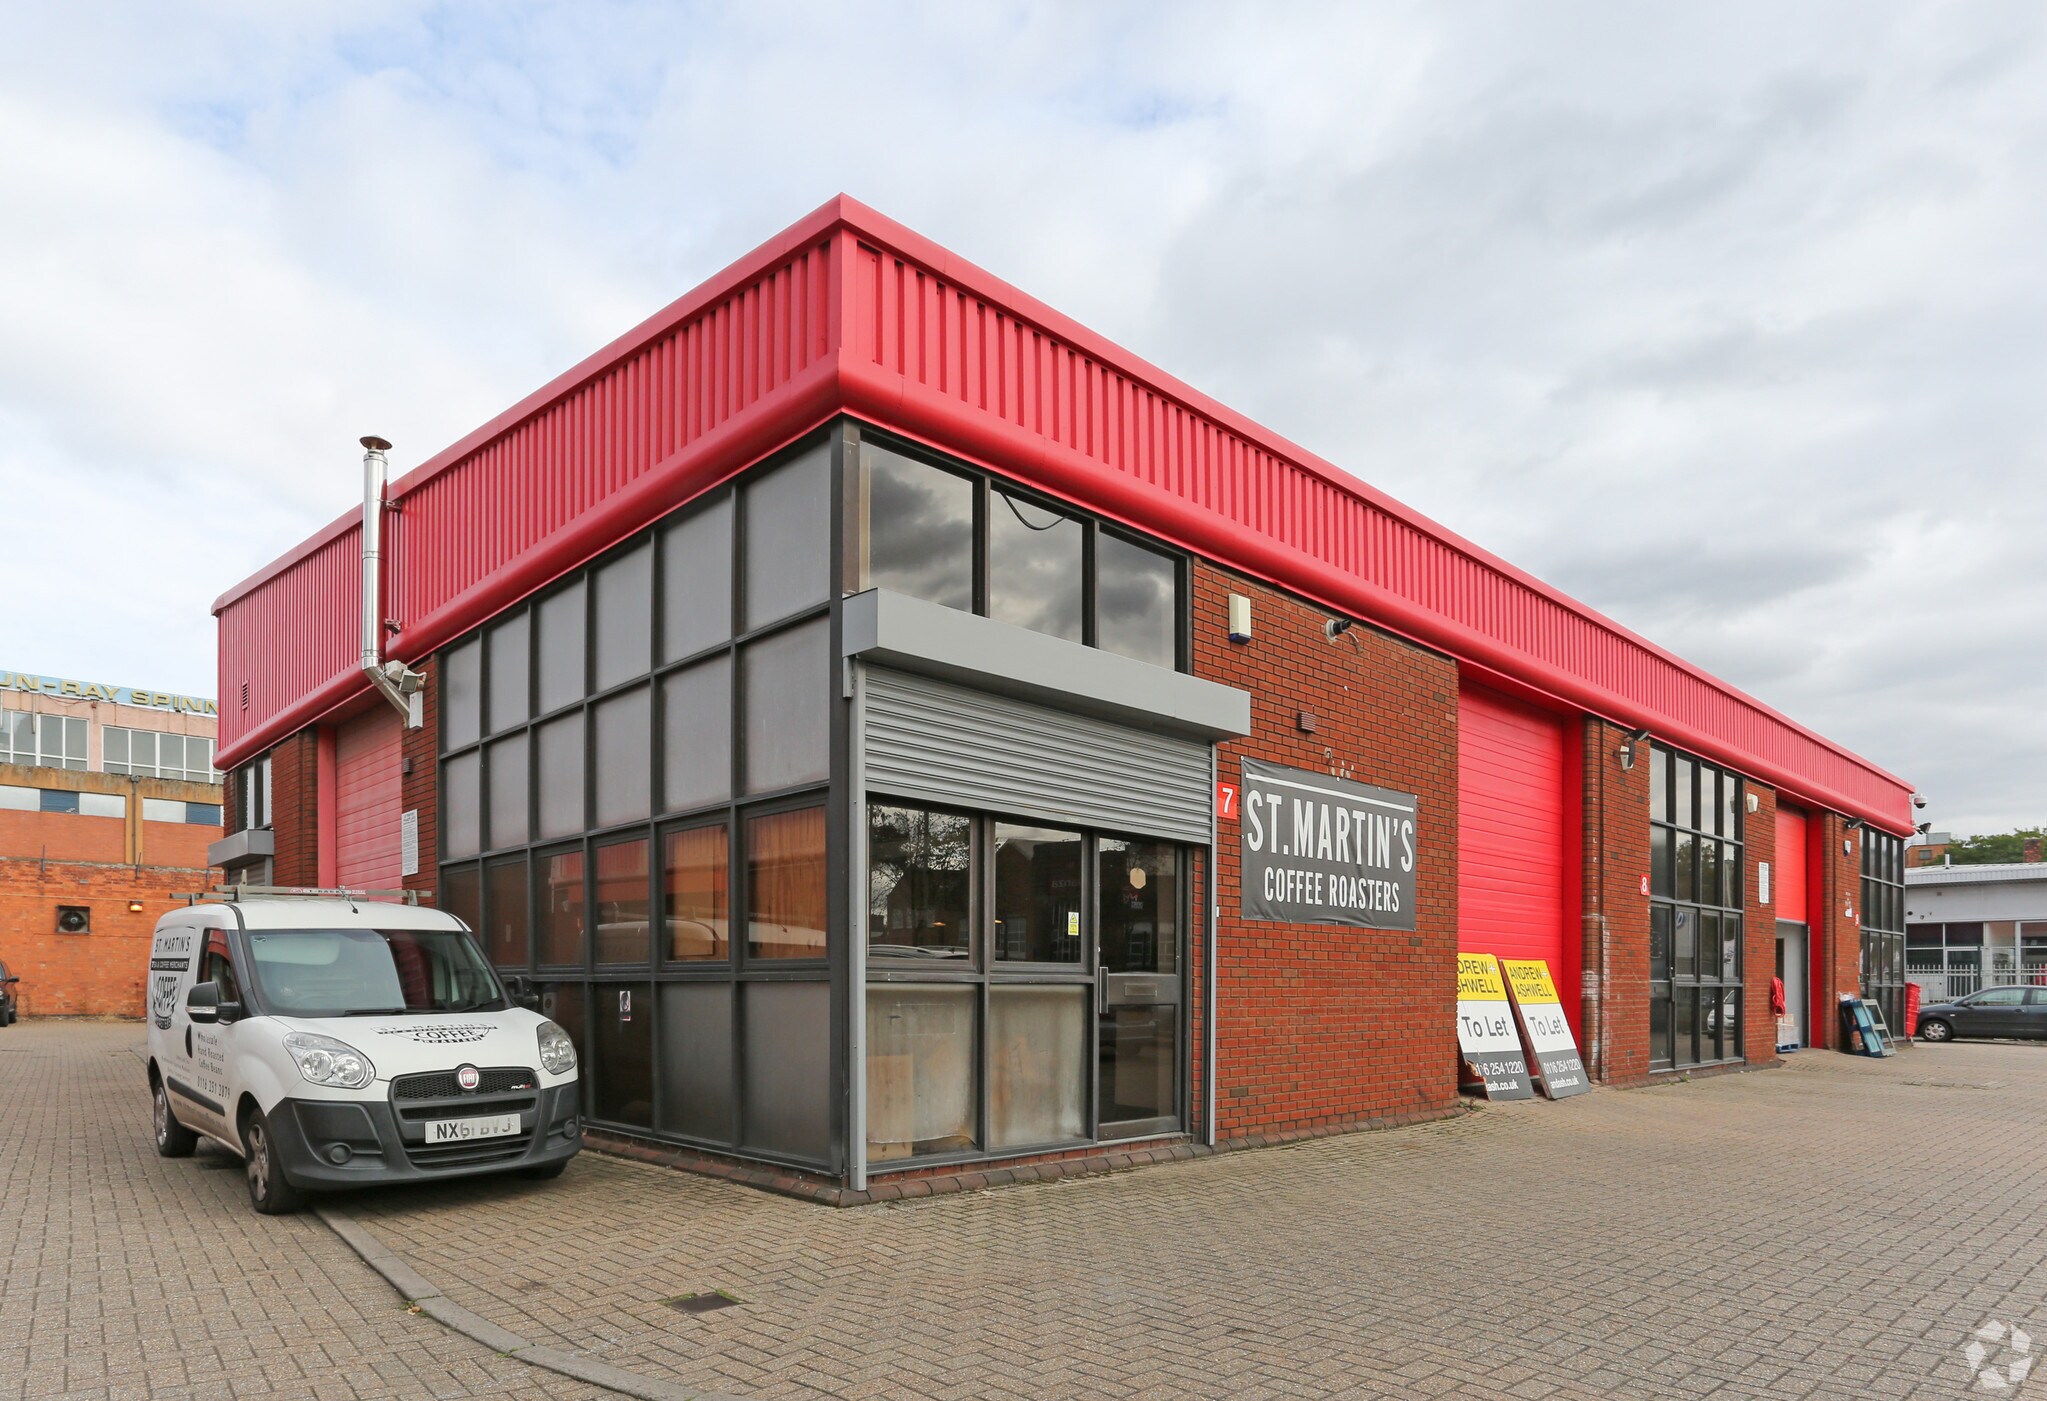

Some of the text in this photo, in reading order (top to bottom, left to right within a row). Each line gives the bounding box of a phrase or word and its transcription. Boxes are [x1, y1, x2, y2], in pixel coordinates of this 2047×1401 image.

[1222, 787, 1233, 813] 7
[1264, 866, 1400, 913] COFFEE ROASTERS
[1641, 876, 1648, 893] 8
[1515, 983, 1552, 997] ASHWELL
[1461, 1015, 1510, 1038] To Let
[1529, 1015, 1565, 1036] To Let
[415, 1030, 477, 1039] COFFEE
[1490, 1062, 1505, 1076] 254
[1504, 1060, 1524, 1074] 1220
[1543, 1058, 1581, 1075] 0116 254 1220
[463, 1073, 476, 1084] FIAT
